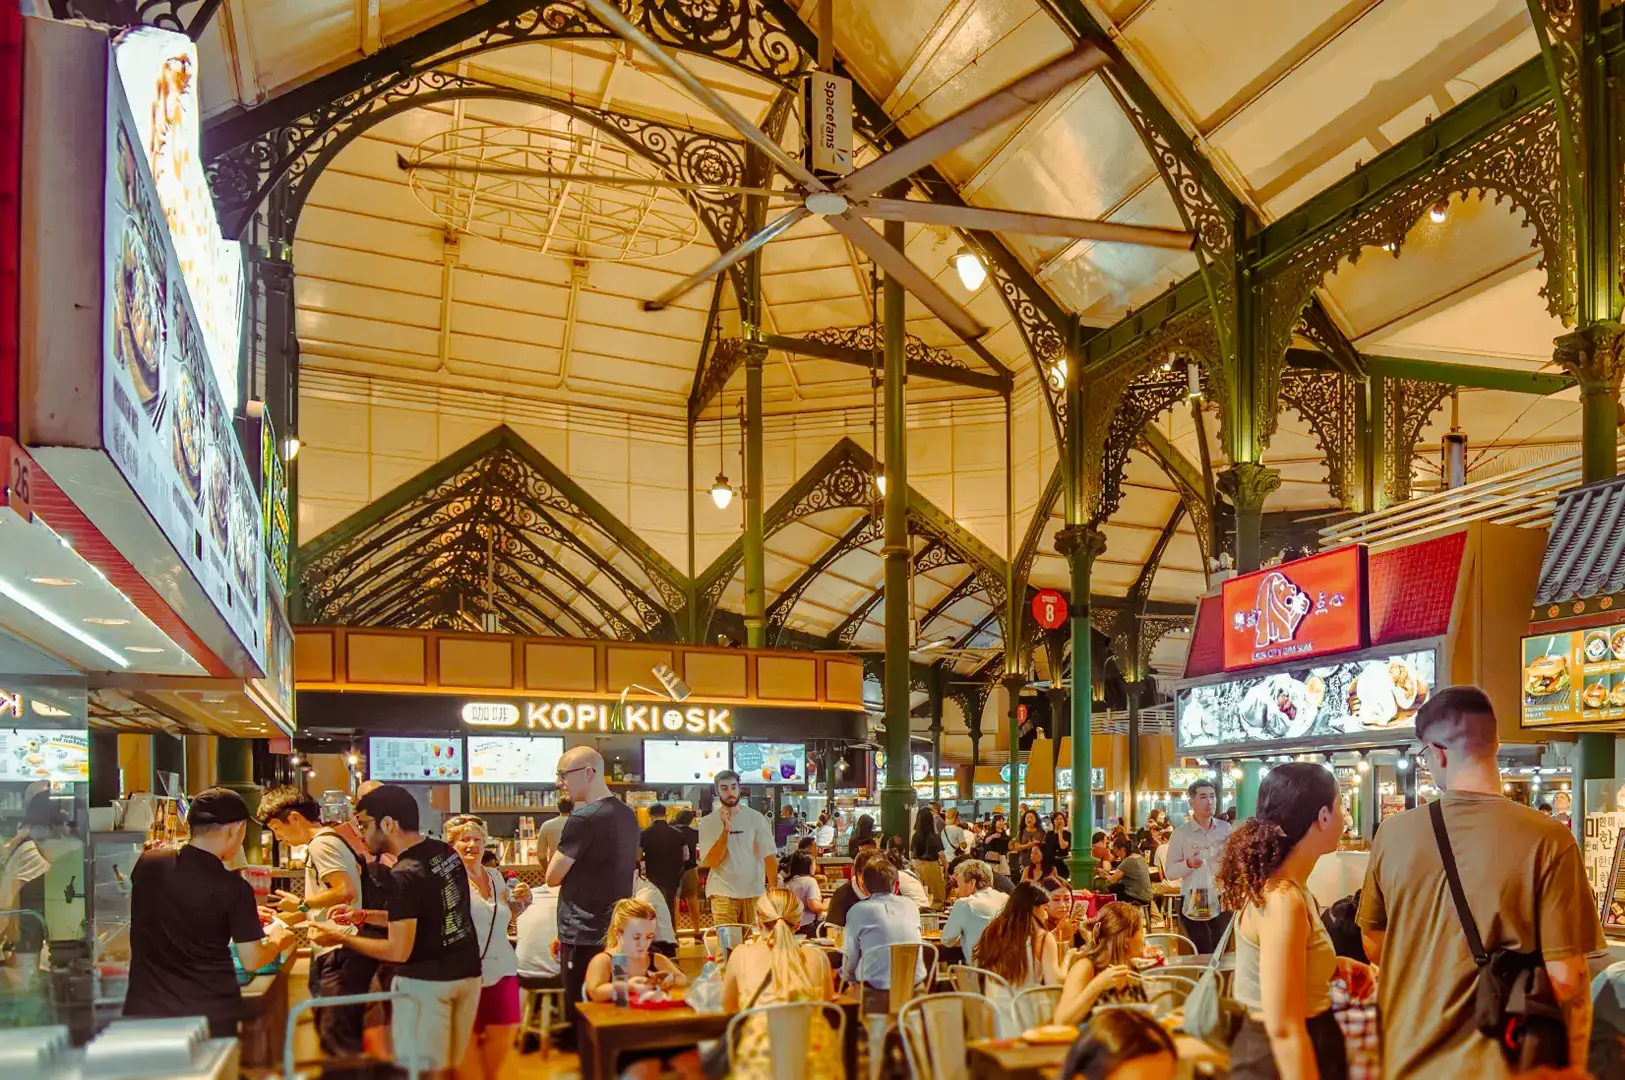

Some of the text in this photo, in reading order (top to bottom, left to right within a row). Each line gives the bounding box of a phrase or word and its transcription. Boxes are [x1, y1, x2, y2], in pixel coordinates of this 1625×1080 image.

[824, 80, 837, 149] Spacefans
[14, 457, 30, 505] 26
[1045, 603, 1055, 623] 8
[526, 701, 732, 734] KOPI KIOSK
